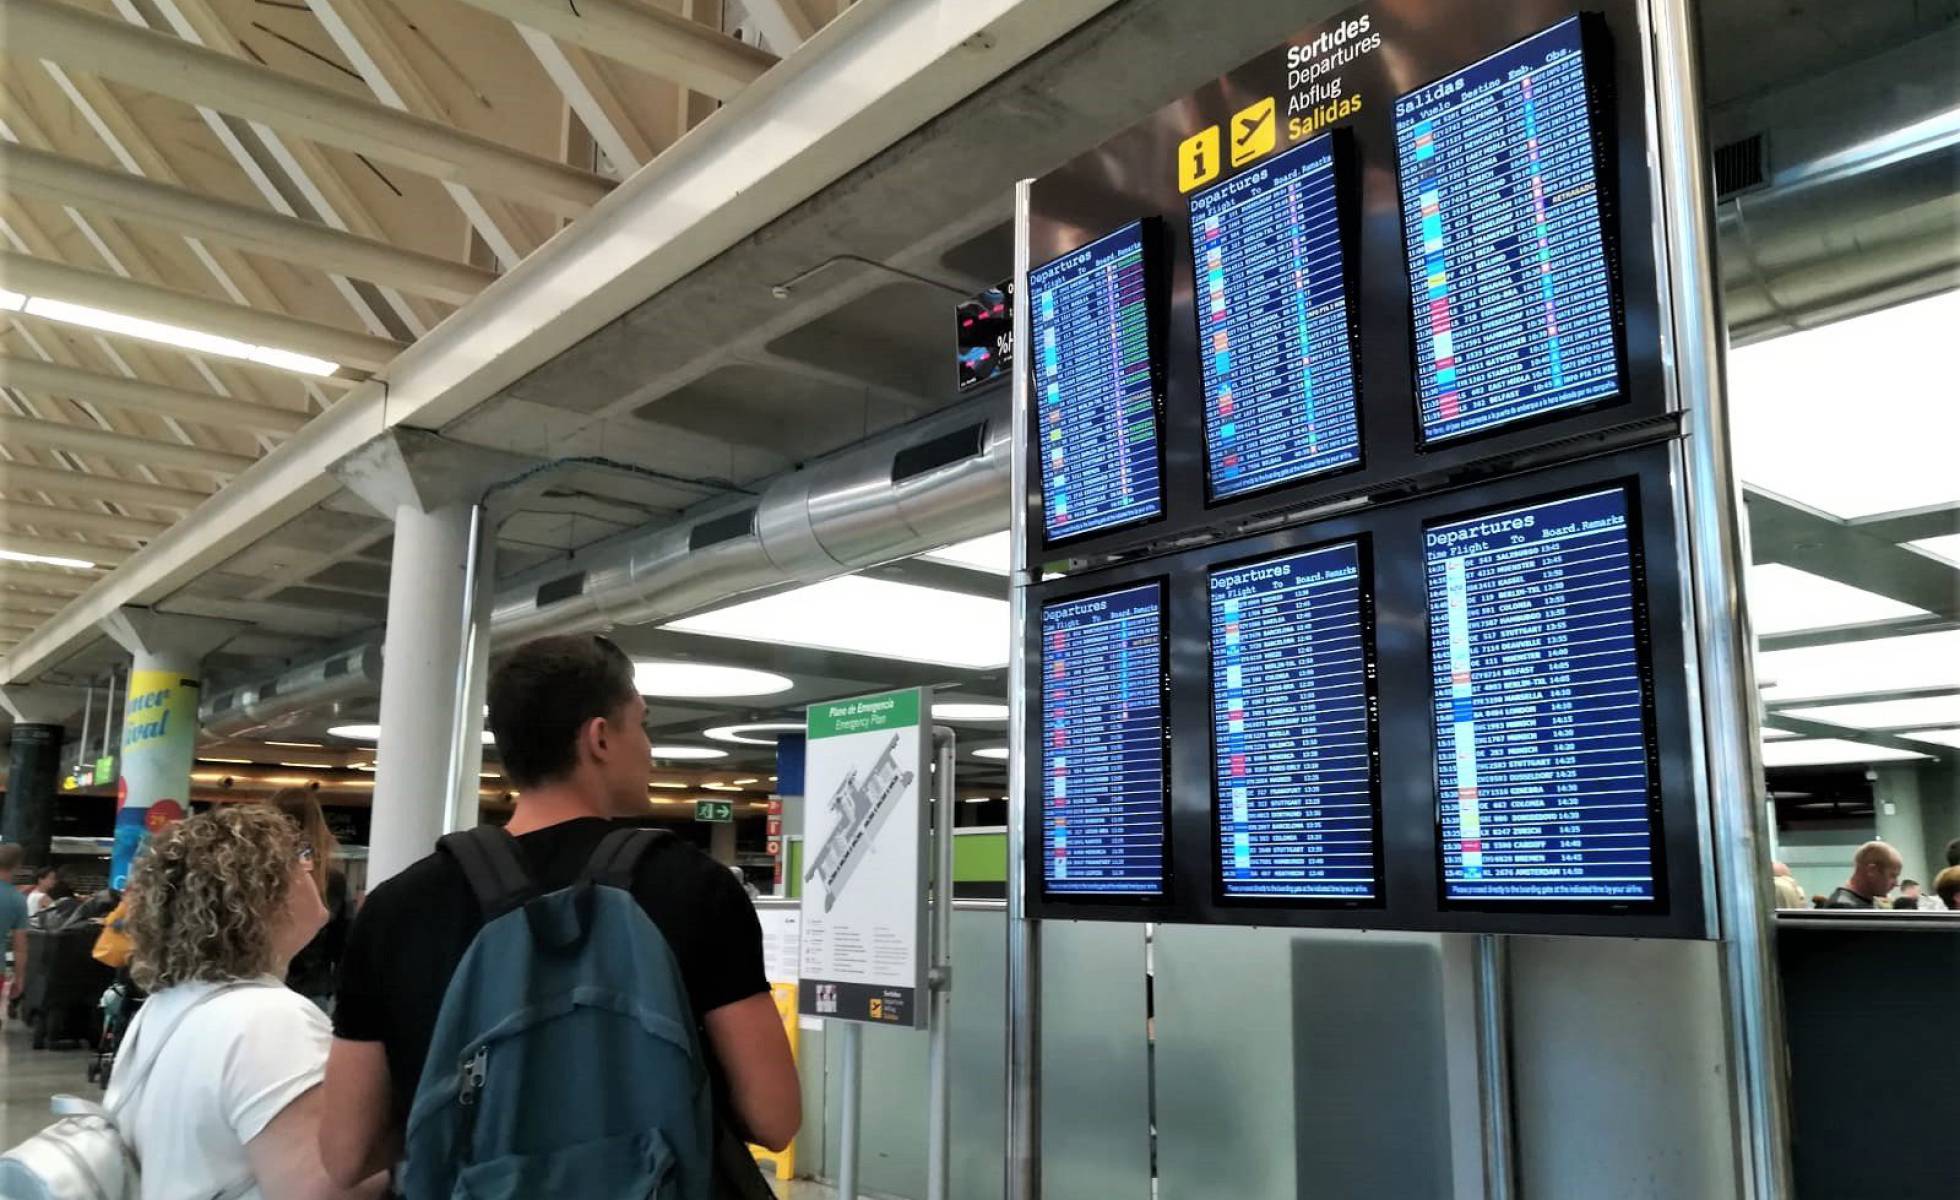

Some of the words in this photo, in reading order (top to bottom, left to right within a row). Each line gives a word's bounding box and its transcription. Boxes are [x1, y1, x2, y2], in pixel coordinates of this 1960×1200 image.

[1288, 14, 1370, 69] Sortides
[1288, 32, 1381, 90] Departures
[1288, 77, 1342, 116] Abflug
[1395, 78, 1465, 117] Salidas
[1420, 102, 1450, 120] Vuelo
[1461, 78, 1500, 102] Destino
[1289, 94, 1362, 140] Salidas
[1191, 169, 1269, 212] Departures
[1208, 200, 1236, 216] Flight
[1251, 187, 1262, 196] To
[1030, 251, 1092, 285] Departures
[1426, 515, 1535, 547] Departures
[1450, 542, 1489, 556] Flight
[1510, 535, 1525, 544] To
[1542, 523, 1581, 538] Board.
[1582, 514, 1625, 530] Remarks
[1210, 564, 1291, 590] Departures
[1228, 586, 1256, 598] Flight
[1043, 600, 1107, 622] Departures
